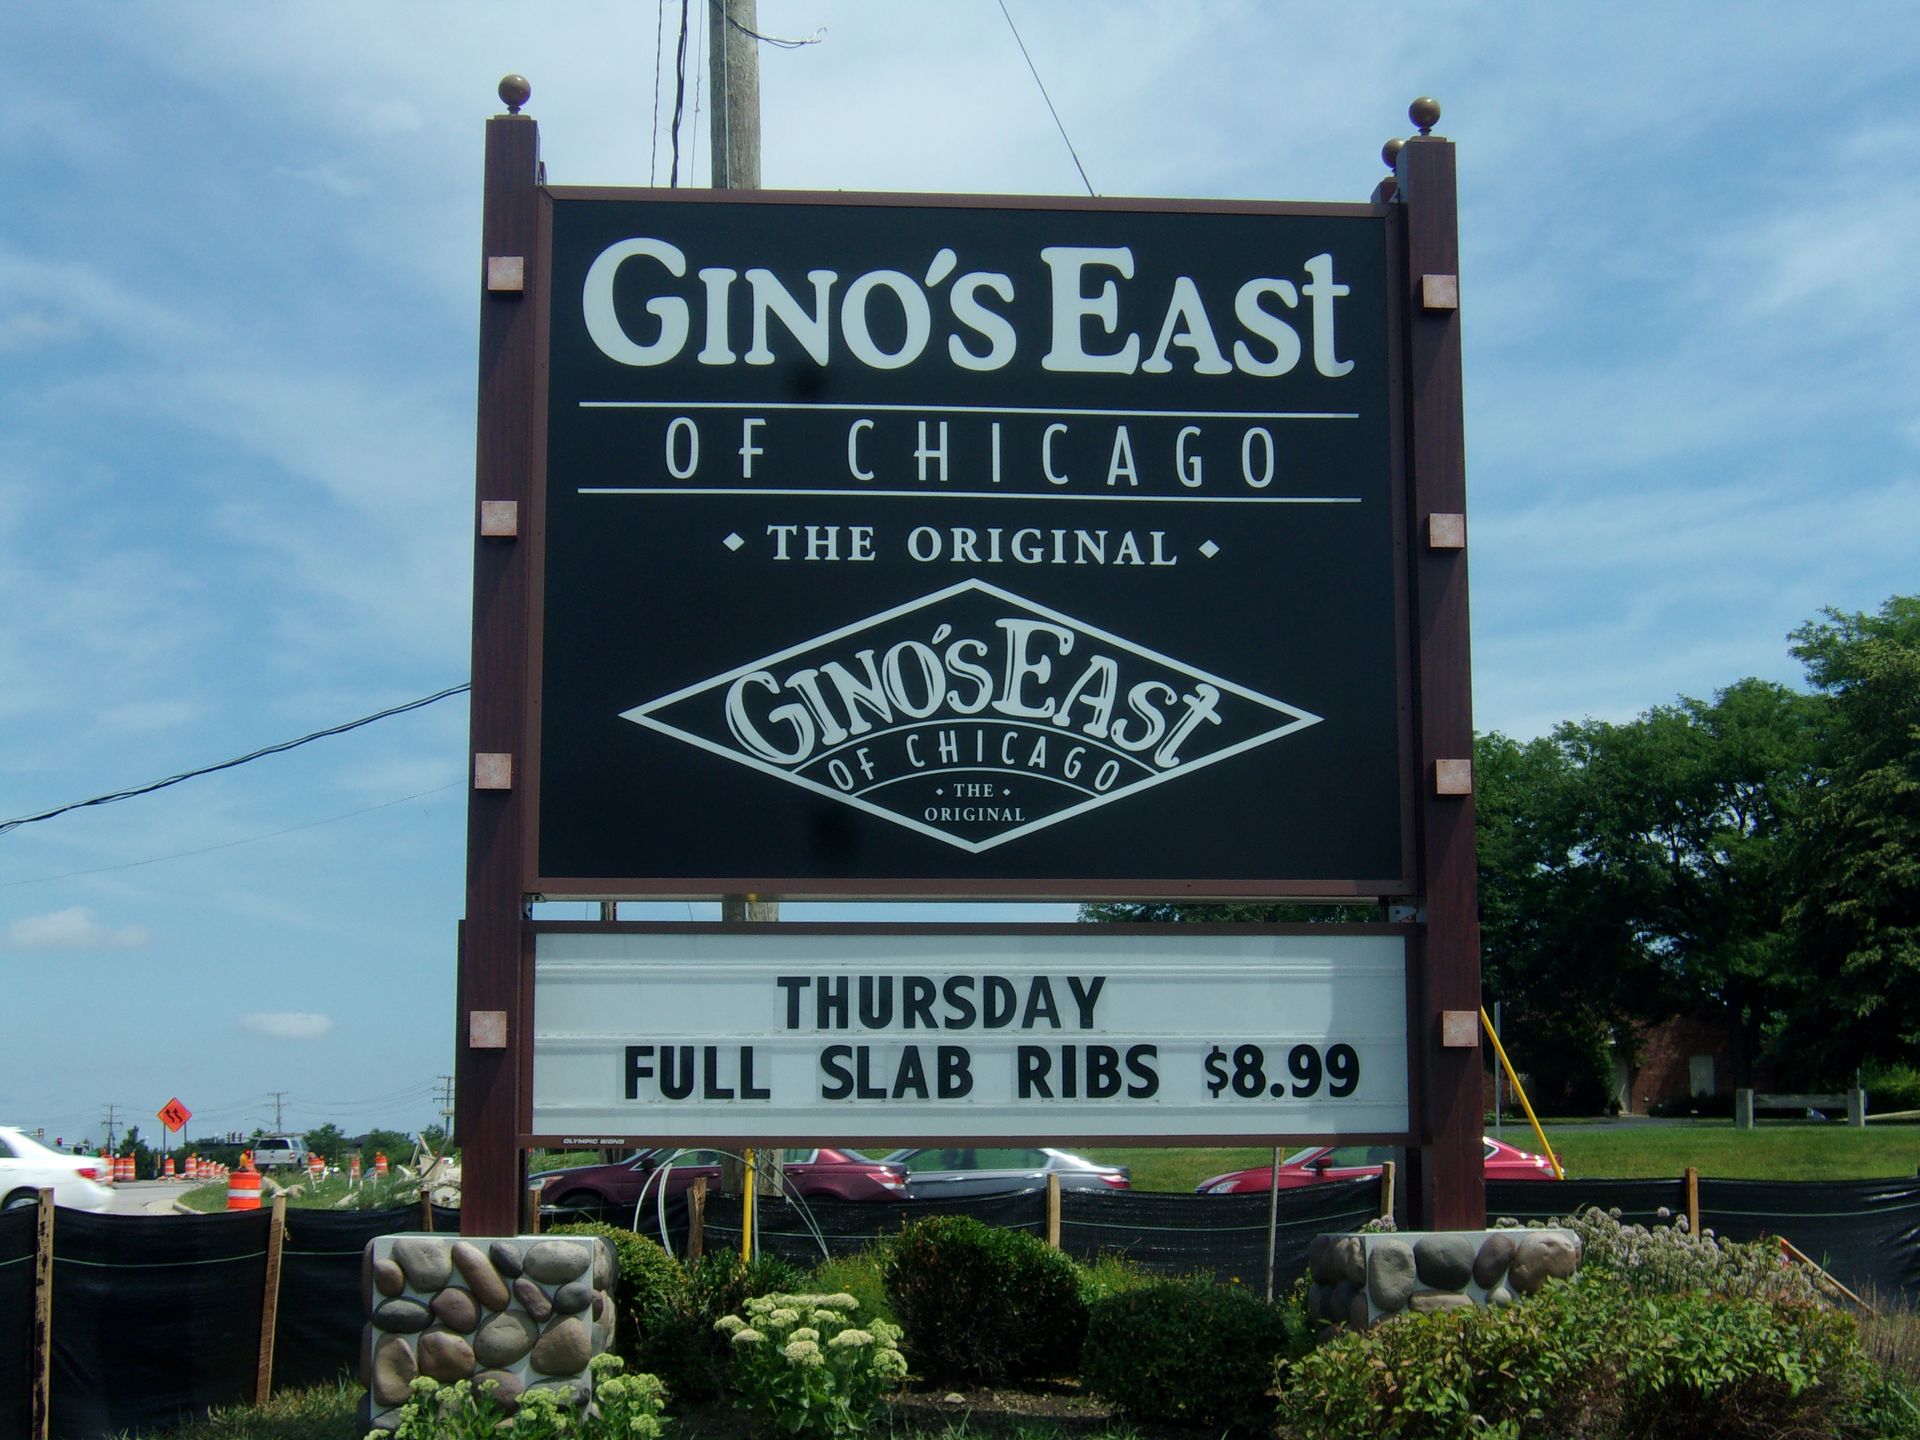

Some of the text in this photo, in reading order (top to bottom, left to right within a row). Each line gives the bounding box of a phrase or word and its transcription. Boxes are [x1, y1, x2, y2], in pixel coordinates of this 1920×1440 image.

[583, 238, 1016, 371] GINO'S
[666, 418, 1275, 488] OF CHICAGO
[767, 526, 1176, 565] THE ORIGINAL
[724, 623, 993, 765] GINO'S
[827, 731, 1121, 792] OF CHICAGO
[924, 807, 1025, 822] ORIGINAL
[953, 783, 994, 798] THE
[778, 976, 1105, 1029] THURSDAY
[626, 1044, 1359, 1099] FULL SLAB RIBS $8.99
